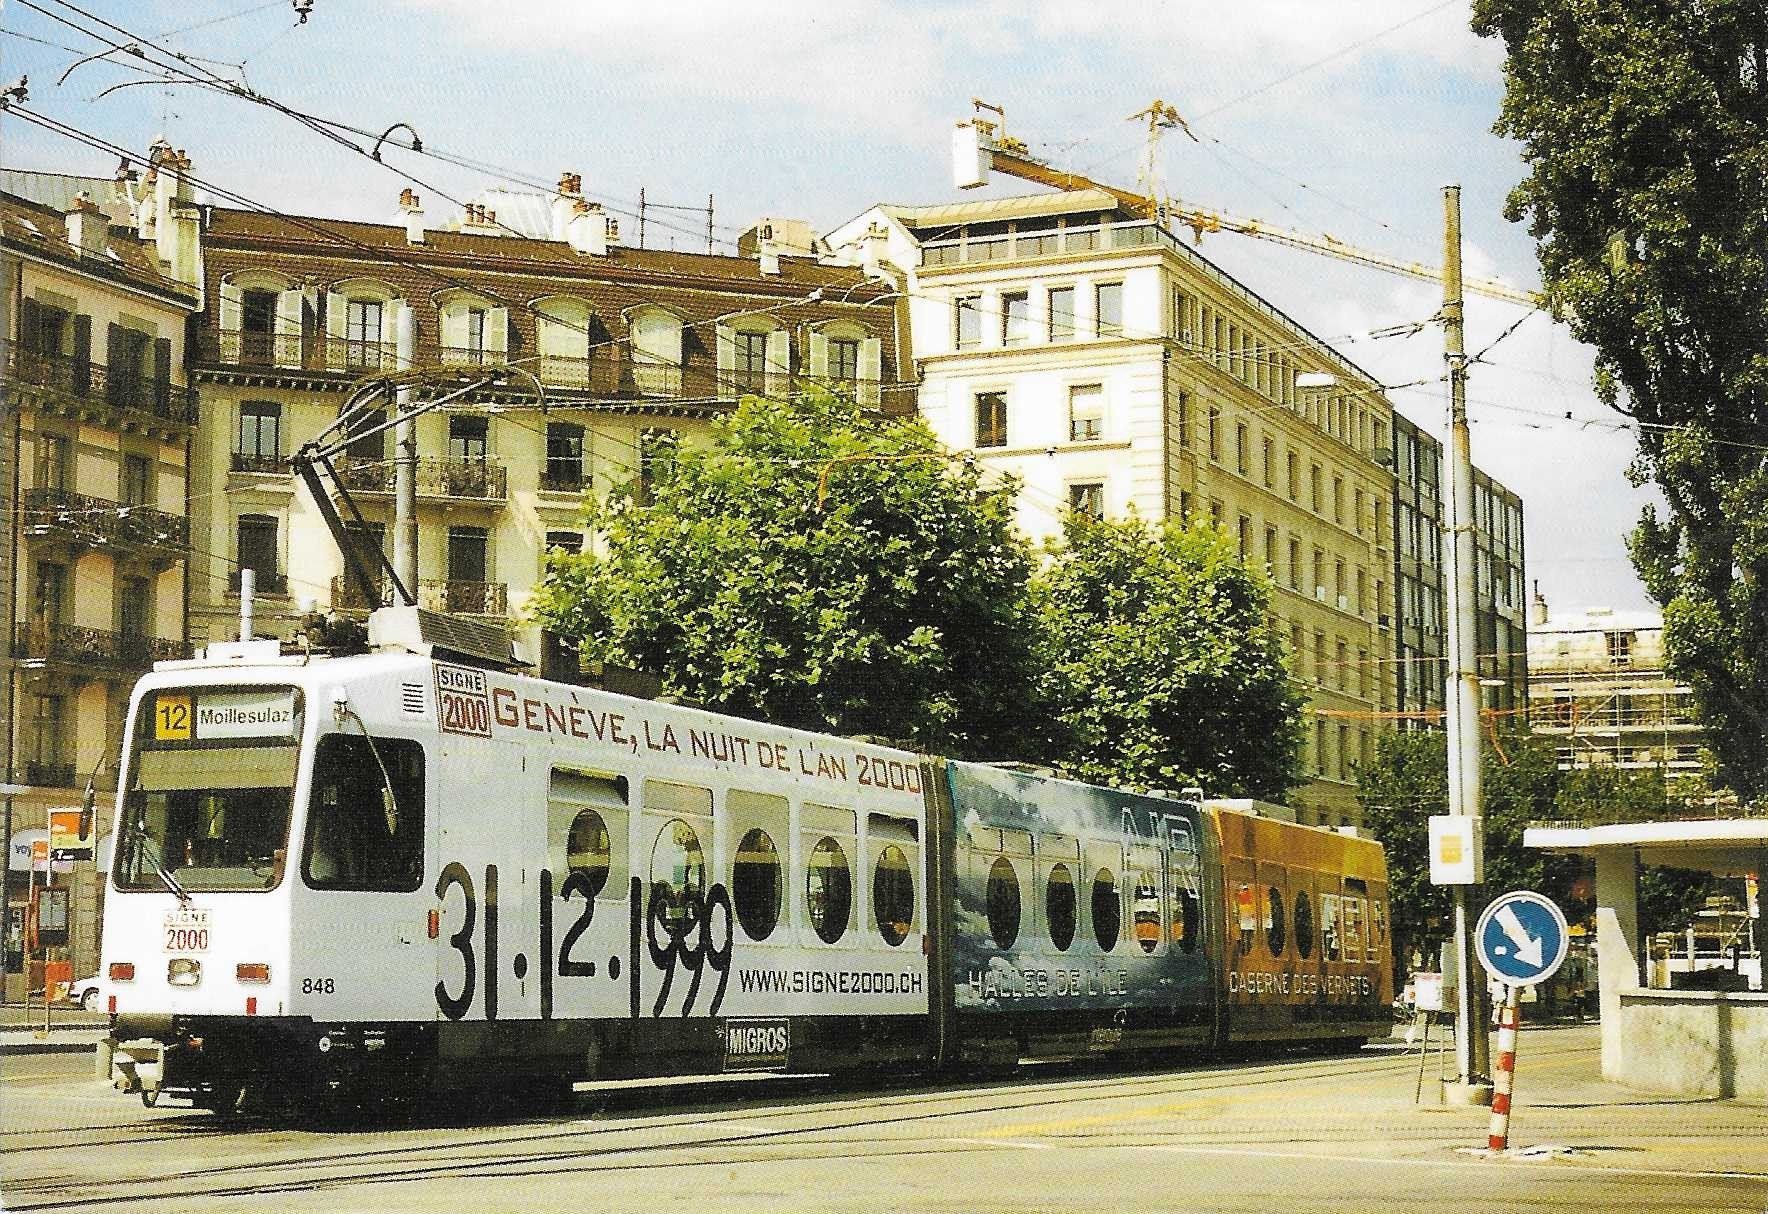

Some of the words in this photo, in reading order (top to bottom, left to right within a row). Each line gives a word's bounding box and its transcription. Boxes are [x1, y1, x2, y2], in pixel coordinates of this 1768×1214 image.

[440, 669, 483, 691] SIGNE
[160, 703, 189, 731] 12
[200, 707, 290, 726] Moillesulaz
[443, 693, 488, 732] 2000
[643, 719, 681, 754] LA
[689, 728, 750, 766] NUIT
[756, 741, 791, 772] DE
[799, 741, 847, 781] L'AN
[855, 754, 921, 794] 2000
[166, 912, 208, 923] SIGNE
[166, 928, 209, 951] 2000
[302, 977, 336, 995] 848
[739, 968, 923, 994] WWW.SIGNE2000.CH
[968, 968, 1049, 998] HALLES
[1056, 969, 1081, 997] DE
[1229, 971, 1290, 995] CASERNE
[1293, 973, 1318, 995] DES
[1320, 974, 1371, 997] VERNETS
[729, 1026, 787, 1054] MIGROS
